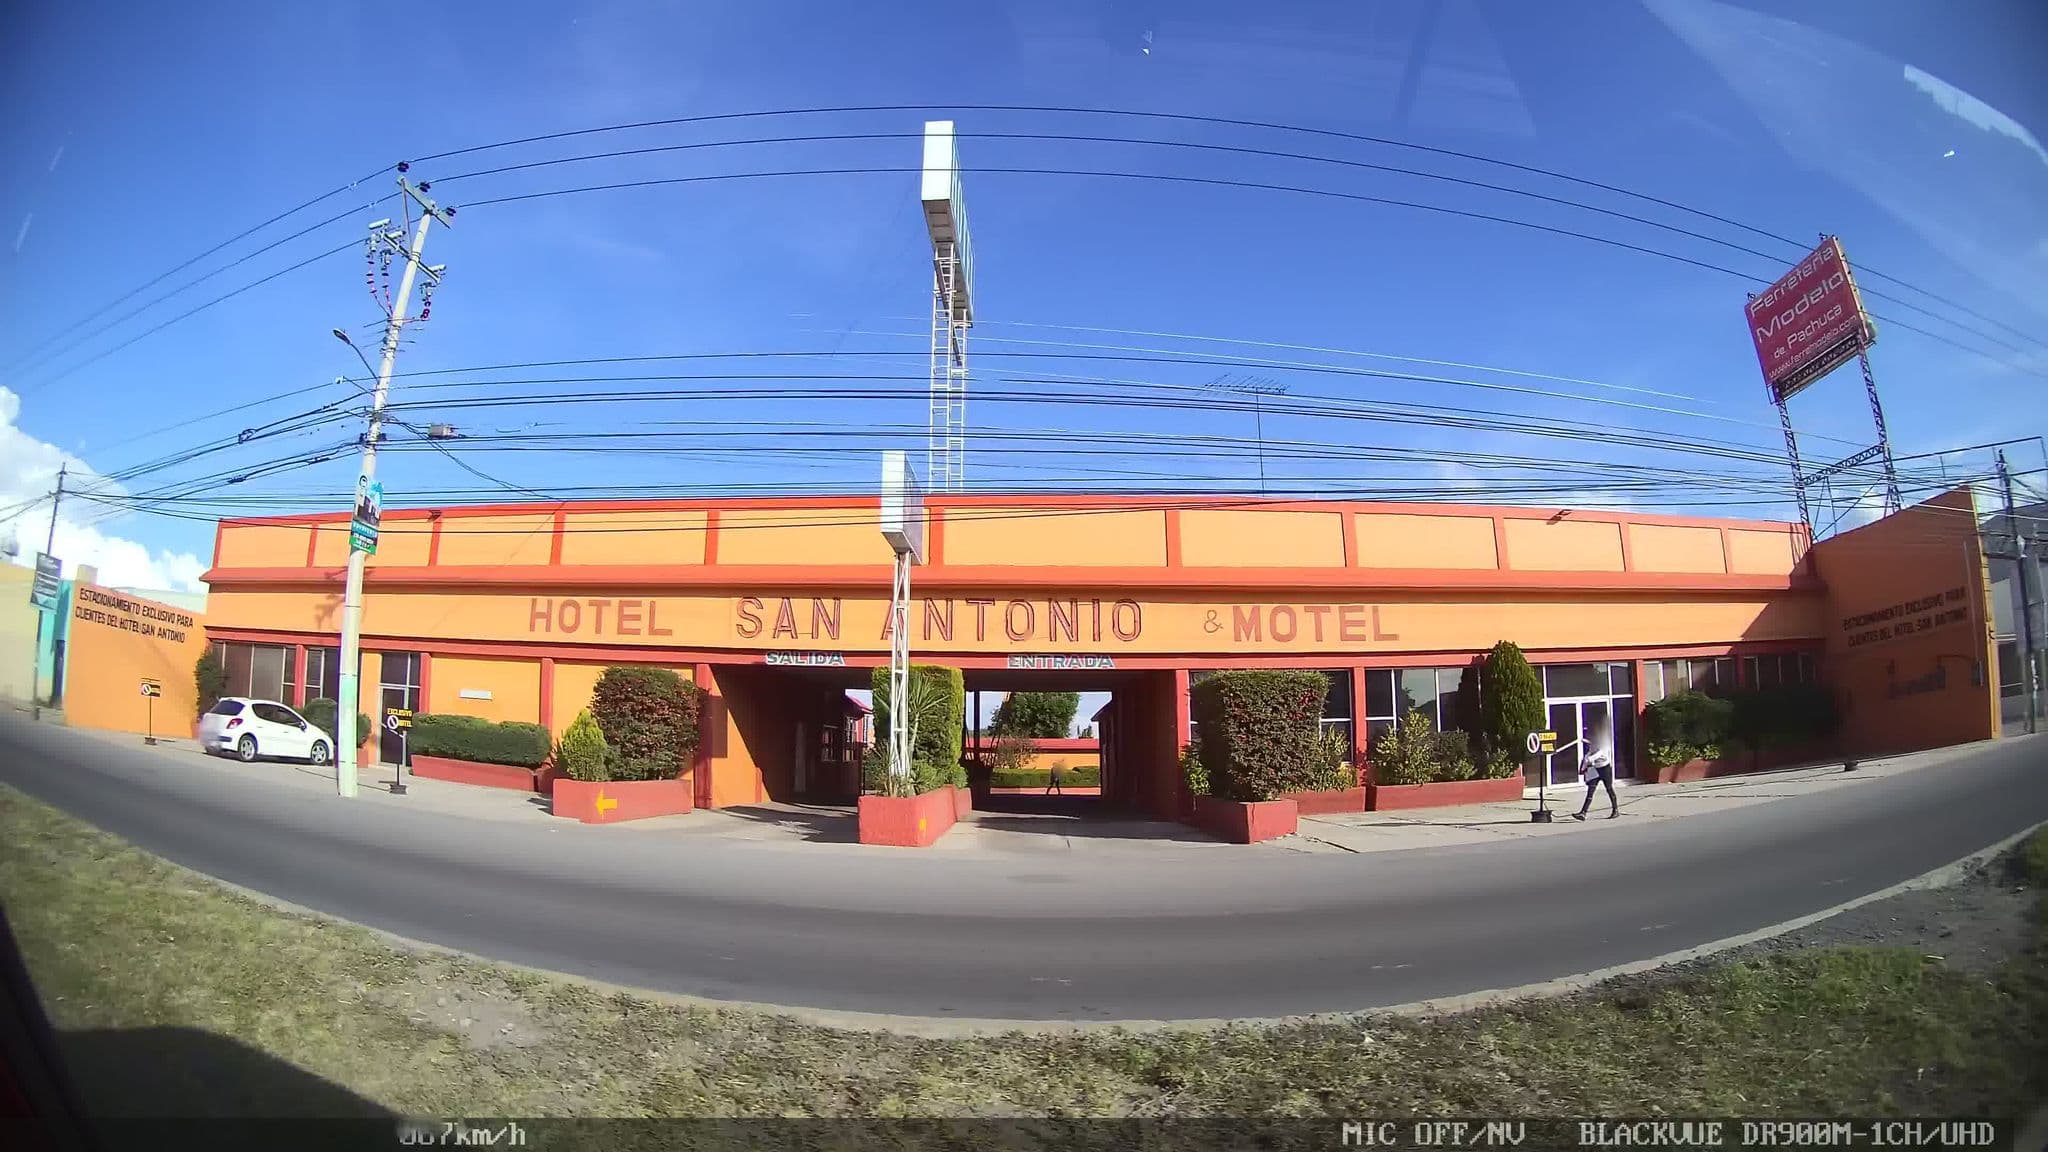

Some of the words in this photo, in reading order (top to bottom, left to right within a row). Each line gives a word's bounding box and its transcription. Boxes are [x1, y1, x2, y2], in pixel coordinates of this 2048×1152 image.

[1756, 271, 1845, 344] Modelo
[1773, 345, 1787, 359] de
[1786, 304, 1843, 349] Pachuca
[75, 605, 107, 625] CLIENTES
[106, 614, 119, 628] DEL
[119, 617, 140, 633] HOTEL
[140, 623, 156, 636] SAN
[157, 627, 186, 644] ANTONIO
[79, 587, 141, 615] ESTACIONAMIENTO
[141, 604, 176, 625] EXCLUSIVO
[176, 613, 194, 629] PARA
[529, 598, 673, 636] HOTEL
[735, 596, 841, 640] SAN
[880, 597, 1142, 642] ANTONIO
[1203, 609, 1224, 634] &
[1232, 605, 1400, 642] MOTEL
[766, 651, 845, 667] SALIDA
[1007, 654, 1114, 669] ENTRADA
